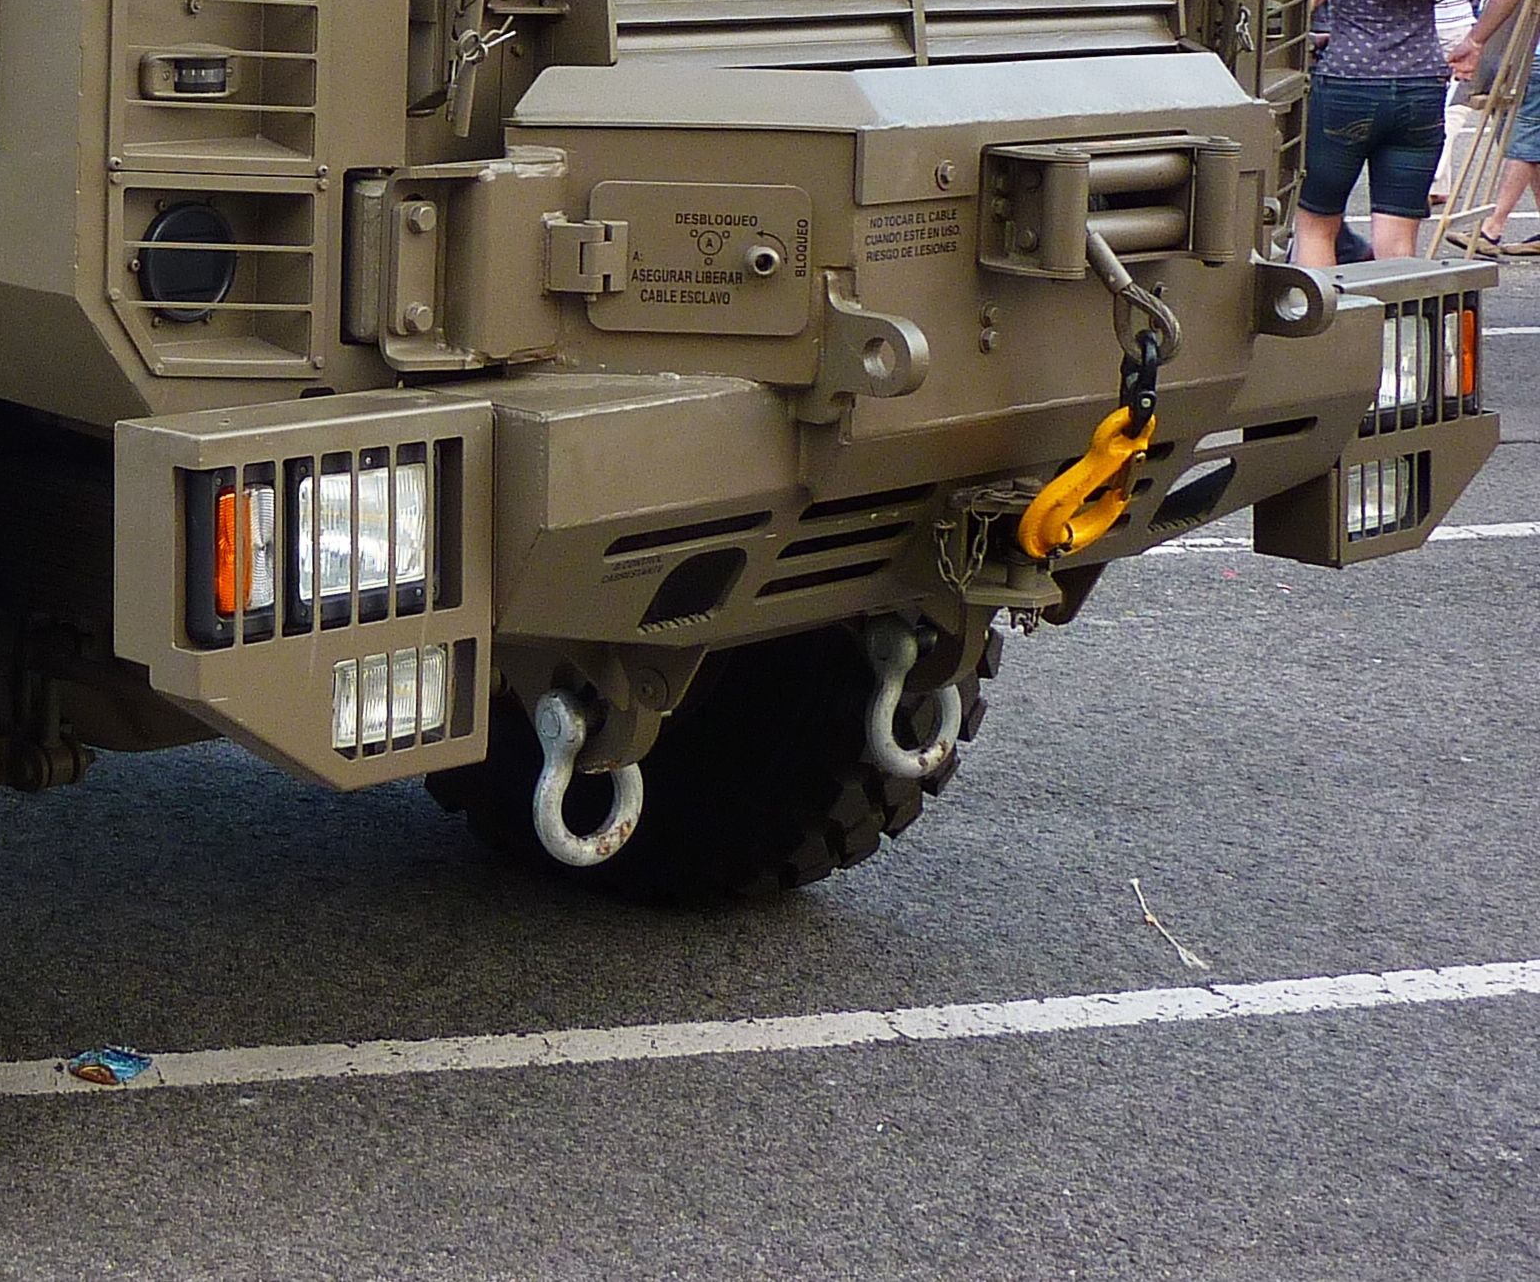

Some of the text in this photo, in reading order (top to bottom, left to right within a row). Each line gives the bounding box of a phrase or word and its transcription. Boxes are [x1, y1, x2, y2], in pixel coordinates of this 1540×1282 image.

[675, 212, 759, 228] DESBLOQUEO
[870, 209, 958, 230] NO TOCAR EL CABLE
[865, 233, 901, 246] CUANDO
[928, 227, 940, 239] EN
[632, 251, 644, 262] A:
[795, 219, 809, 278] BLOQUEO
[866, 241, 958, 262] RIESGO DE LESIONES
[631, 269, 744, 285] ASEGURAR LIBERAR
[640, 288, 732, 306] CABLE ESCLAVO
